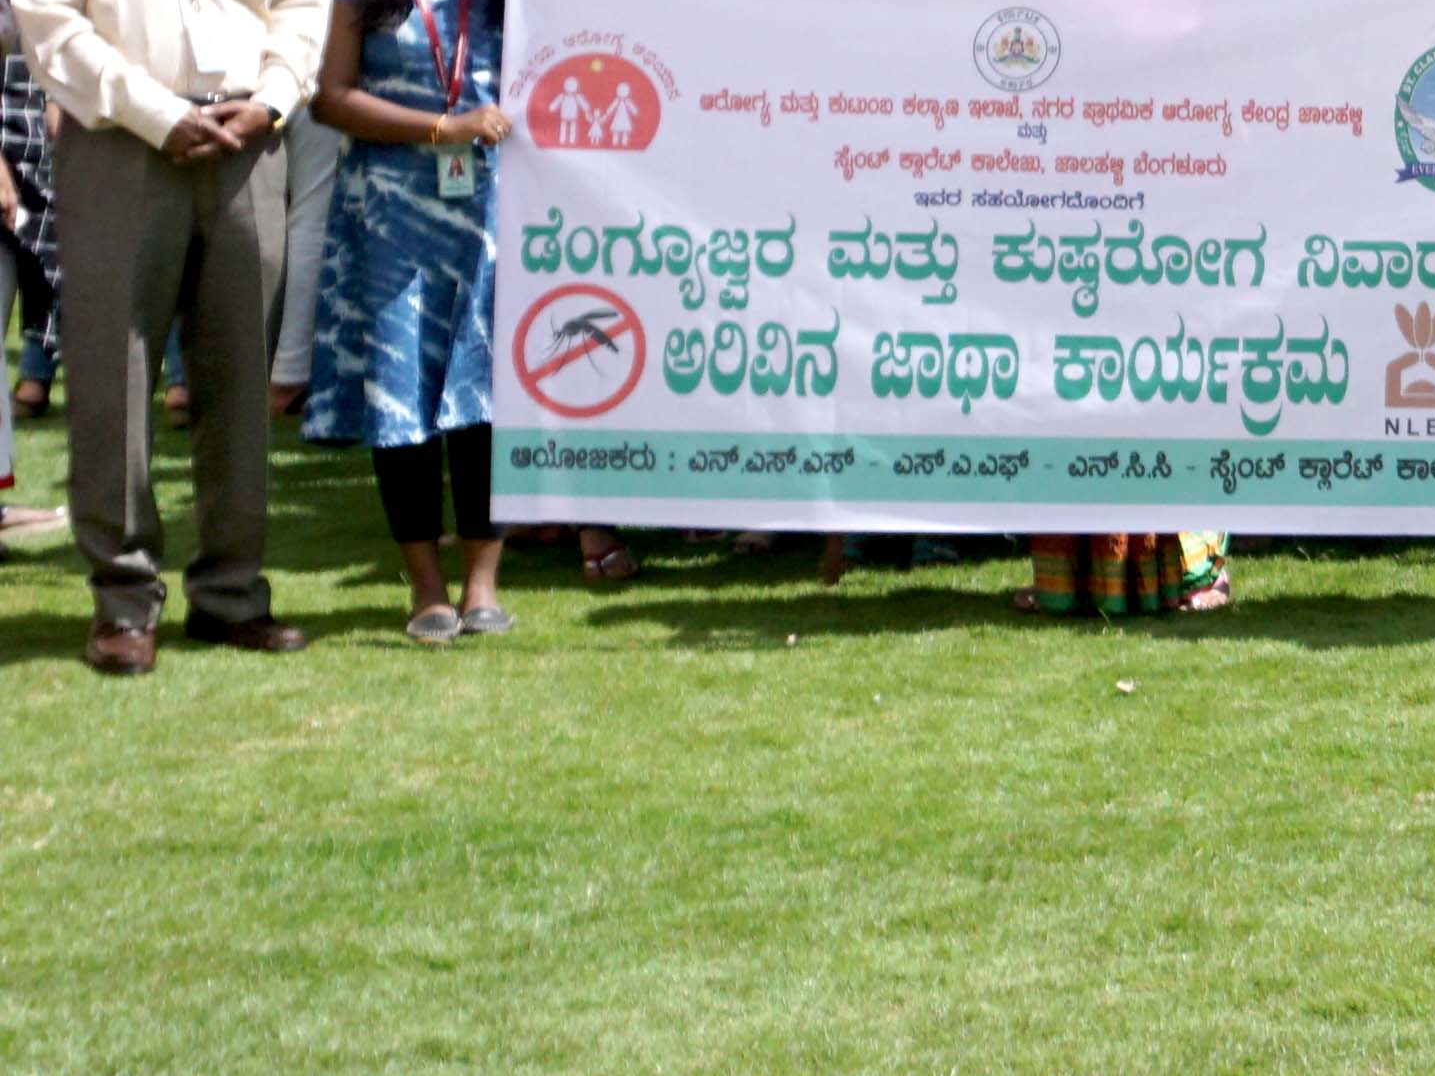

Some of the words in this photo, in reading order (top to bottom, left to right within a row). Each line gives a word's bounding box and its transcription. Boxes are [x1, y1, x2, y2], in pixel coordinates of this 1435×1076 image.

[700, 87, 771, 127] ಆರೋಗ್ಯ
[780, 90, 820, 122] ಮತ್ತು
[828, 92, 893, 116] ಕುಟುಂಬ
[902, 93, 960, 131] ಕಲ್ಯಾಣ
[1031, 96, 1074, 119] ನಗರ
[1083, 96, 1153, 128] ಪ್ರಾಥಮಿಕ
[1162, 98, 1233, 136] ಆರೋಗ್ಯ
[1241, 100, 1290, 132] ಕೇಂದ್ರ
[1133, 154, 1226, 178] ಬೆಂಗಳೂರು
[914, 188, 963, 209] ಇವರ
[521, 206, 797, 312] ಡೆಂಗ್ಯೂಜ್ವರ
[827, 214, 960, 306] ಮತ್ತು
[992, 217, 1268, 319] ಕುಷ್ಠರೋಗ
[662, 306, 842, 397] ಅರಿವಿನ
[870, 331, 1020, 416] ಜಾಥಾ
[1053, 313, 1350, 438] ಕಾರ್ಯಕ್ರಮ
[511, 439, 656, 473] ಆಯೋಜಕರು
